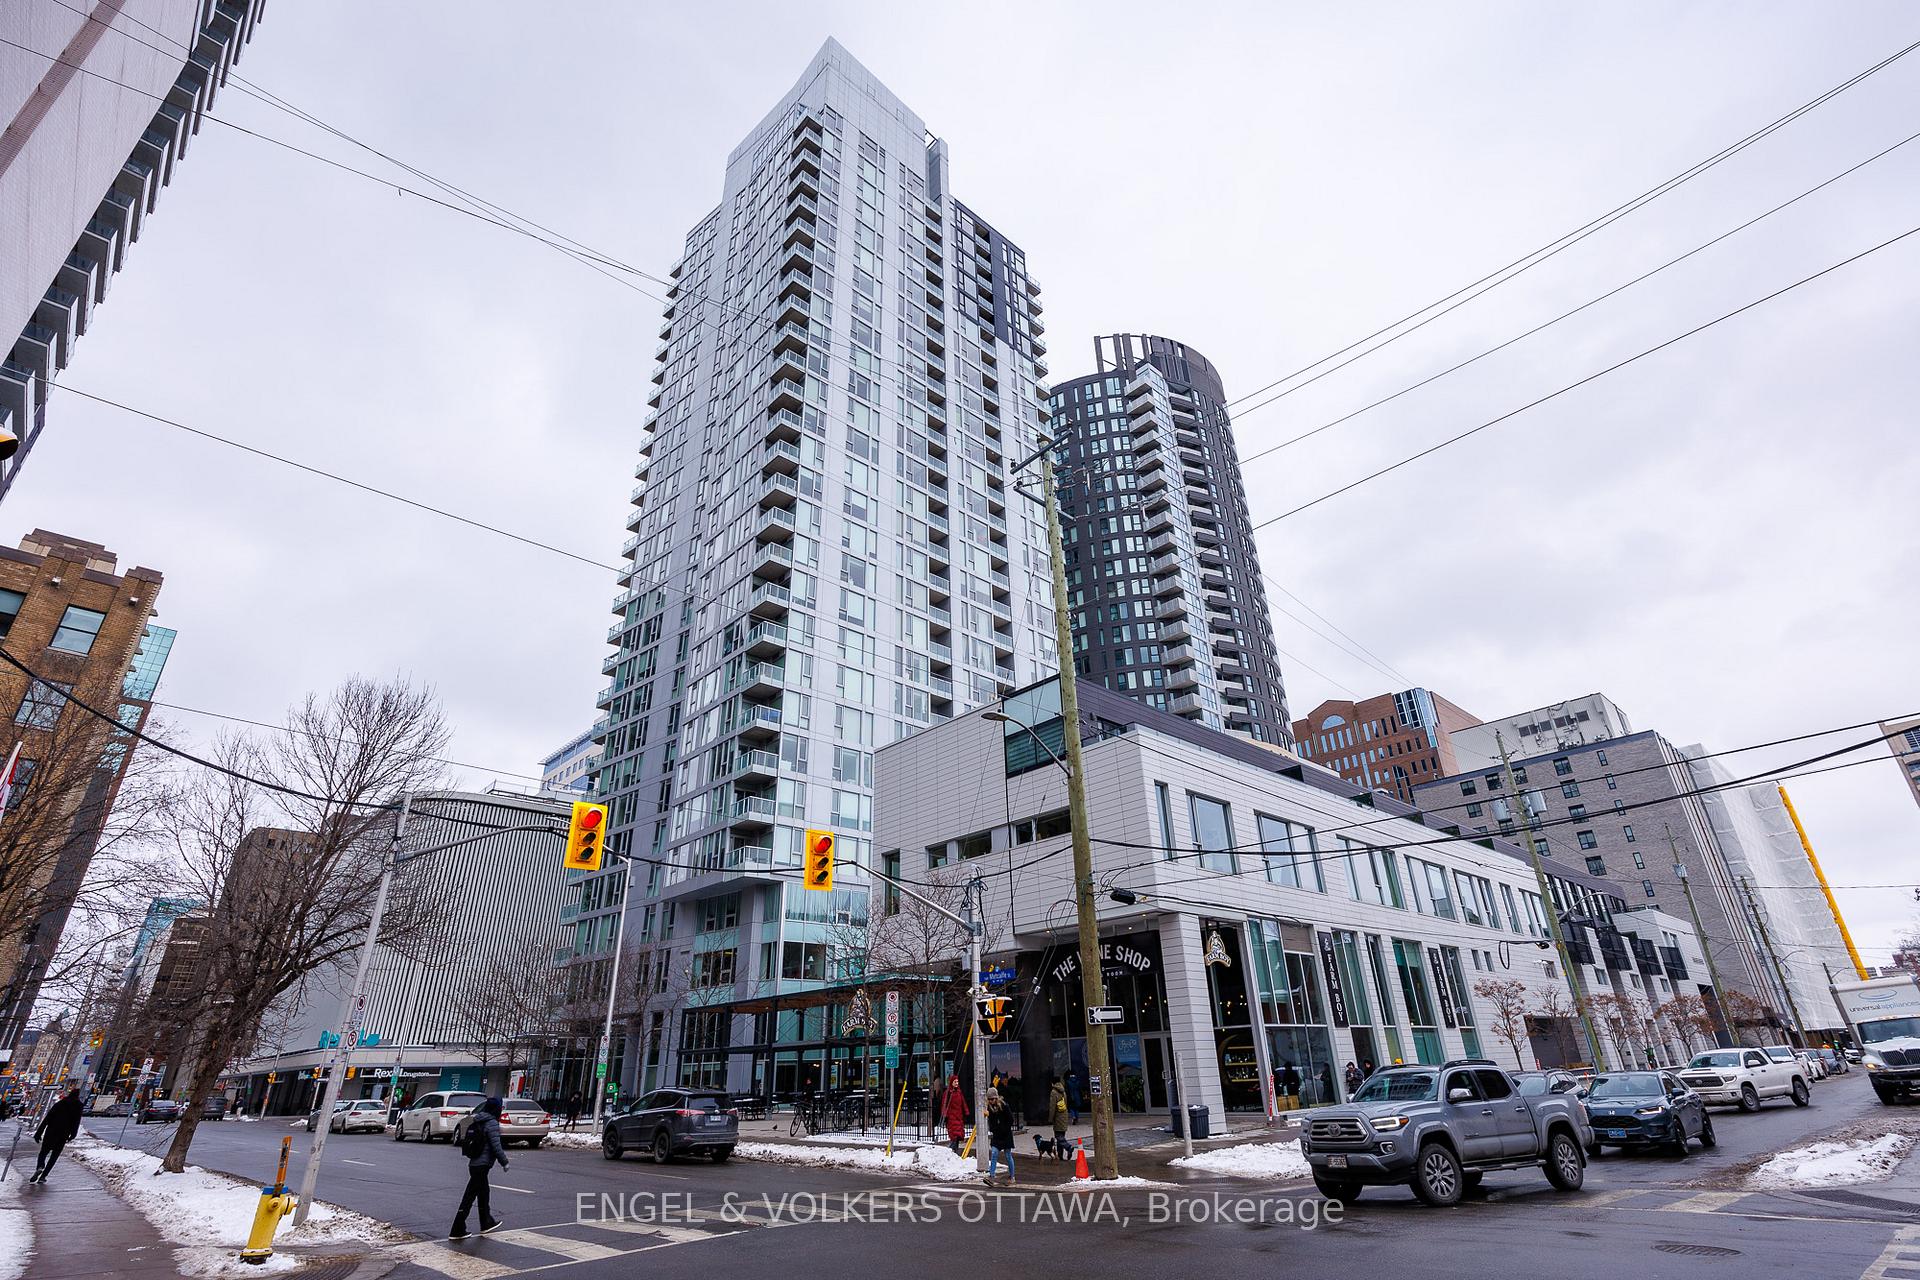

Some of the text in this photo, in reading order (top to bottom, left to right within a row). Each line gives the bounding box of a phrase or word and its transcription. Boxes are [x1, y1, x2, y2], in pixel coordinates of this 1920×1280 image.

[1053, 956, 1076, 981] THE
[1115, 945, 1151, 971] SHOP
[1327, 953, 1344, 1022] FARM BOY
[1436, 966, 1447, 997] FARM
